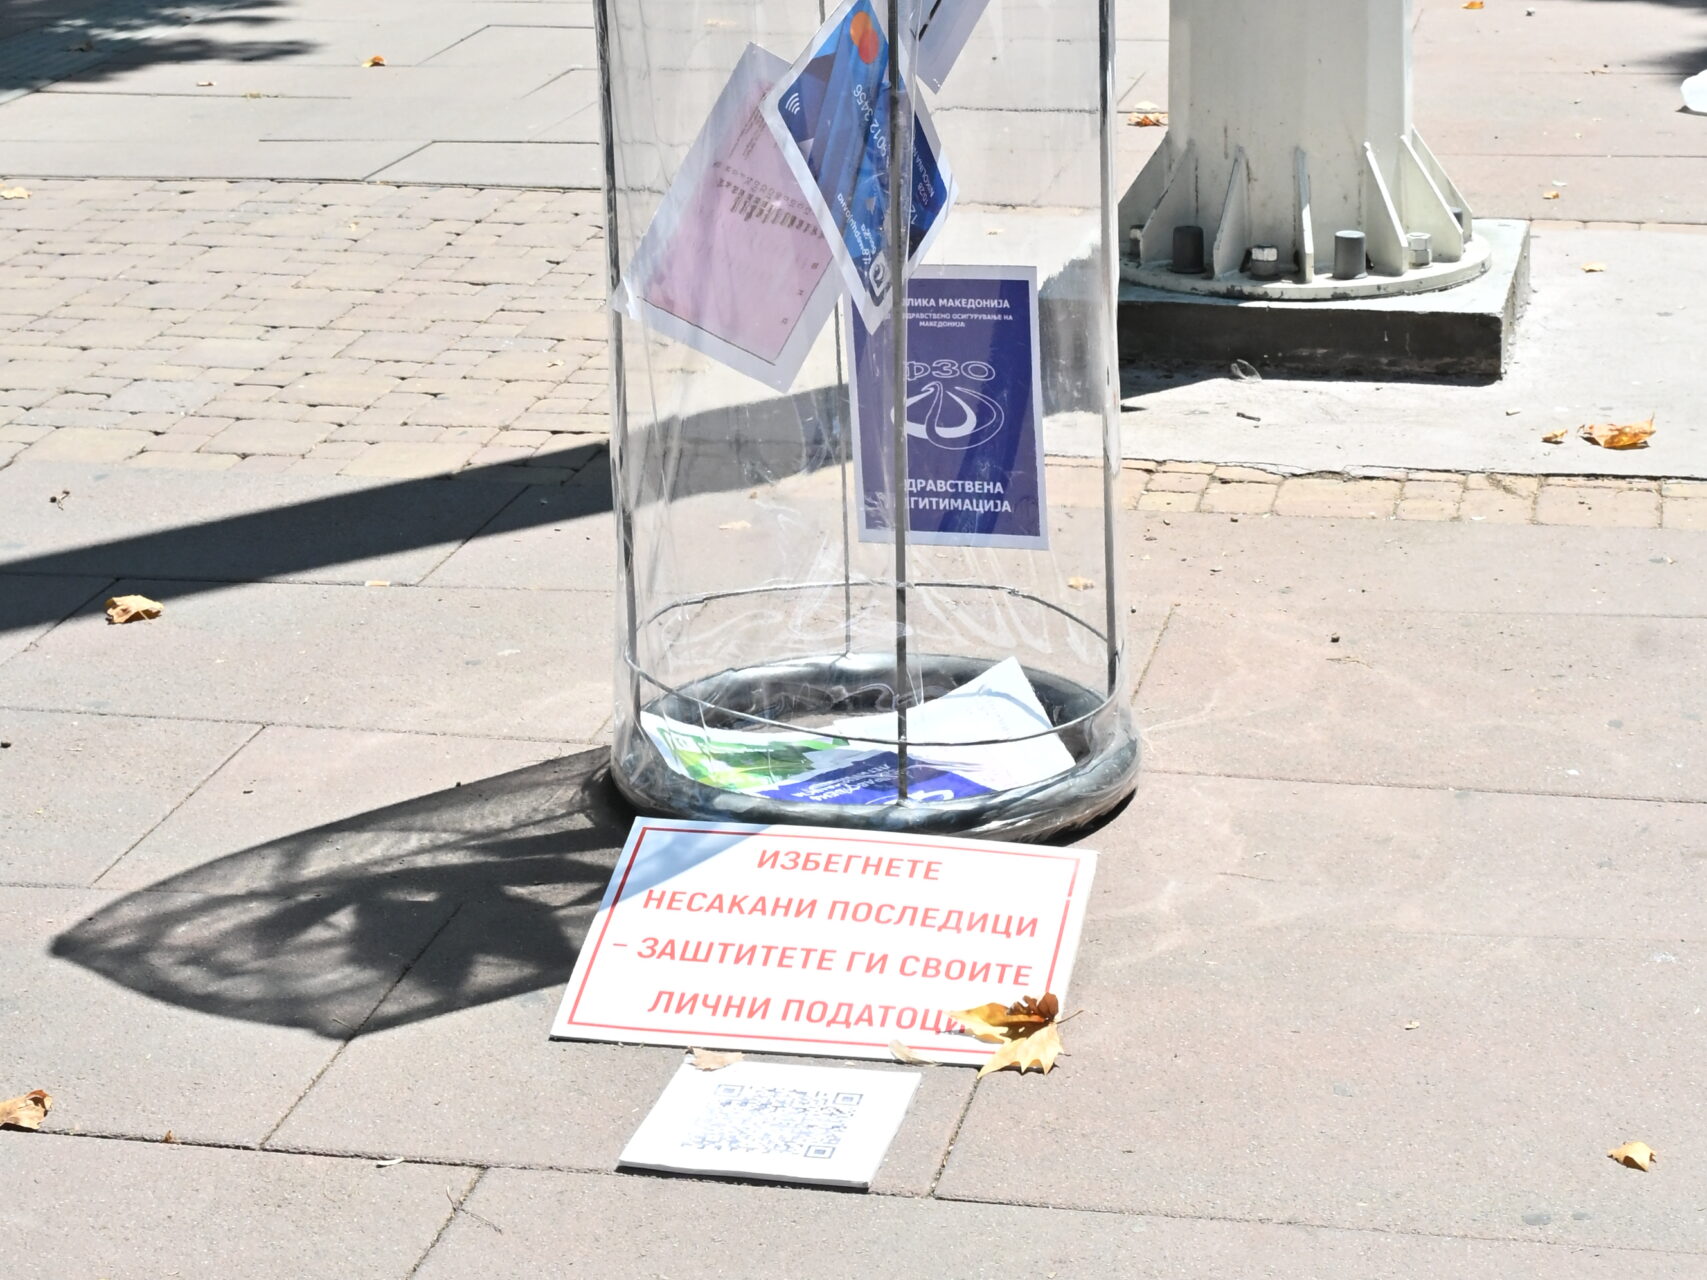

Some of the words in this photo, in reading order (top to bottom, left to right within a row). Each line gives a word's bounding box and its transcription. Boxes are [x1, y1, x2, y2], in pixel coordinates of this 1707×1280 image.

[852, 84, 874, 121] 3456
[938, 298, 1011, 309] МАКЕДОНИЈА
[951, 313, 1002, 321] ОСИГУРУВАЊЕ
[905, 478, 1005, 495] ДРАВСТВЕНА
[905, 496, 1012, 514] ГИТИМАЦИЈА
[757, 849, 943, 881] ИЗБЕГНЕТЕ
[642, 889, 818, 919] НЕСАКАНИ
[827, 900, 1039, 939] ПОСЛЕДИЦИ
[636, 937, 838, 971] ЗАШТИТЕТЕ
[845, 951, 889, 974] ГИ
[898, 955, 1033, 987] СВОИТЕ
[647, 990, 772, 1020] ЛИЧНИ
